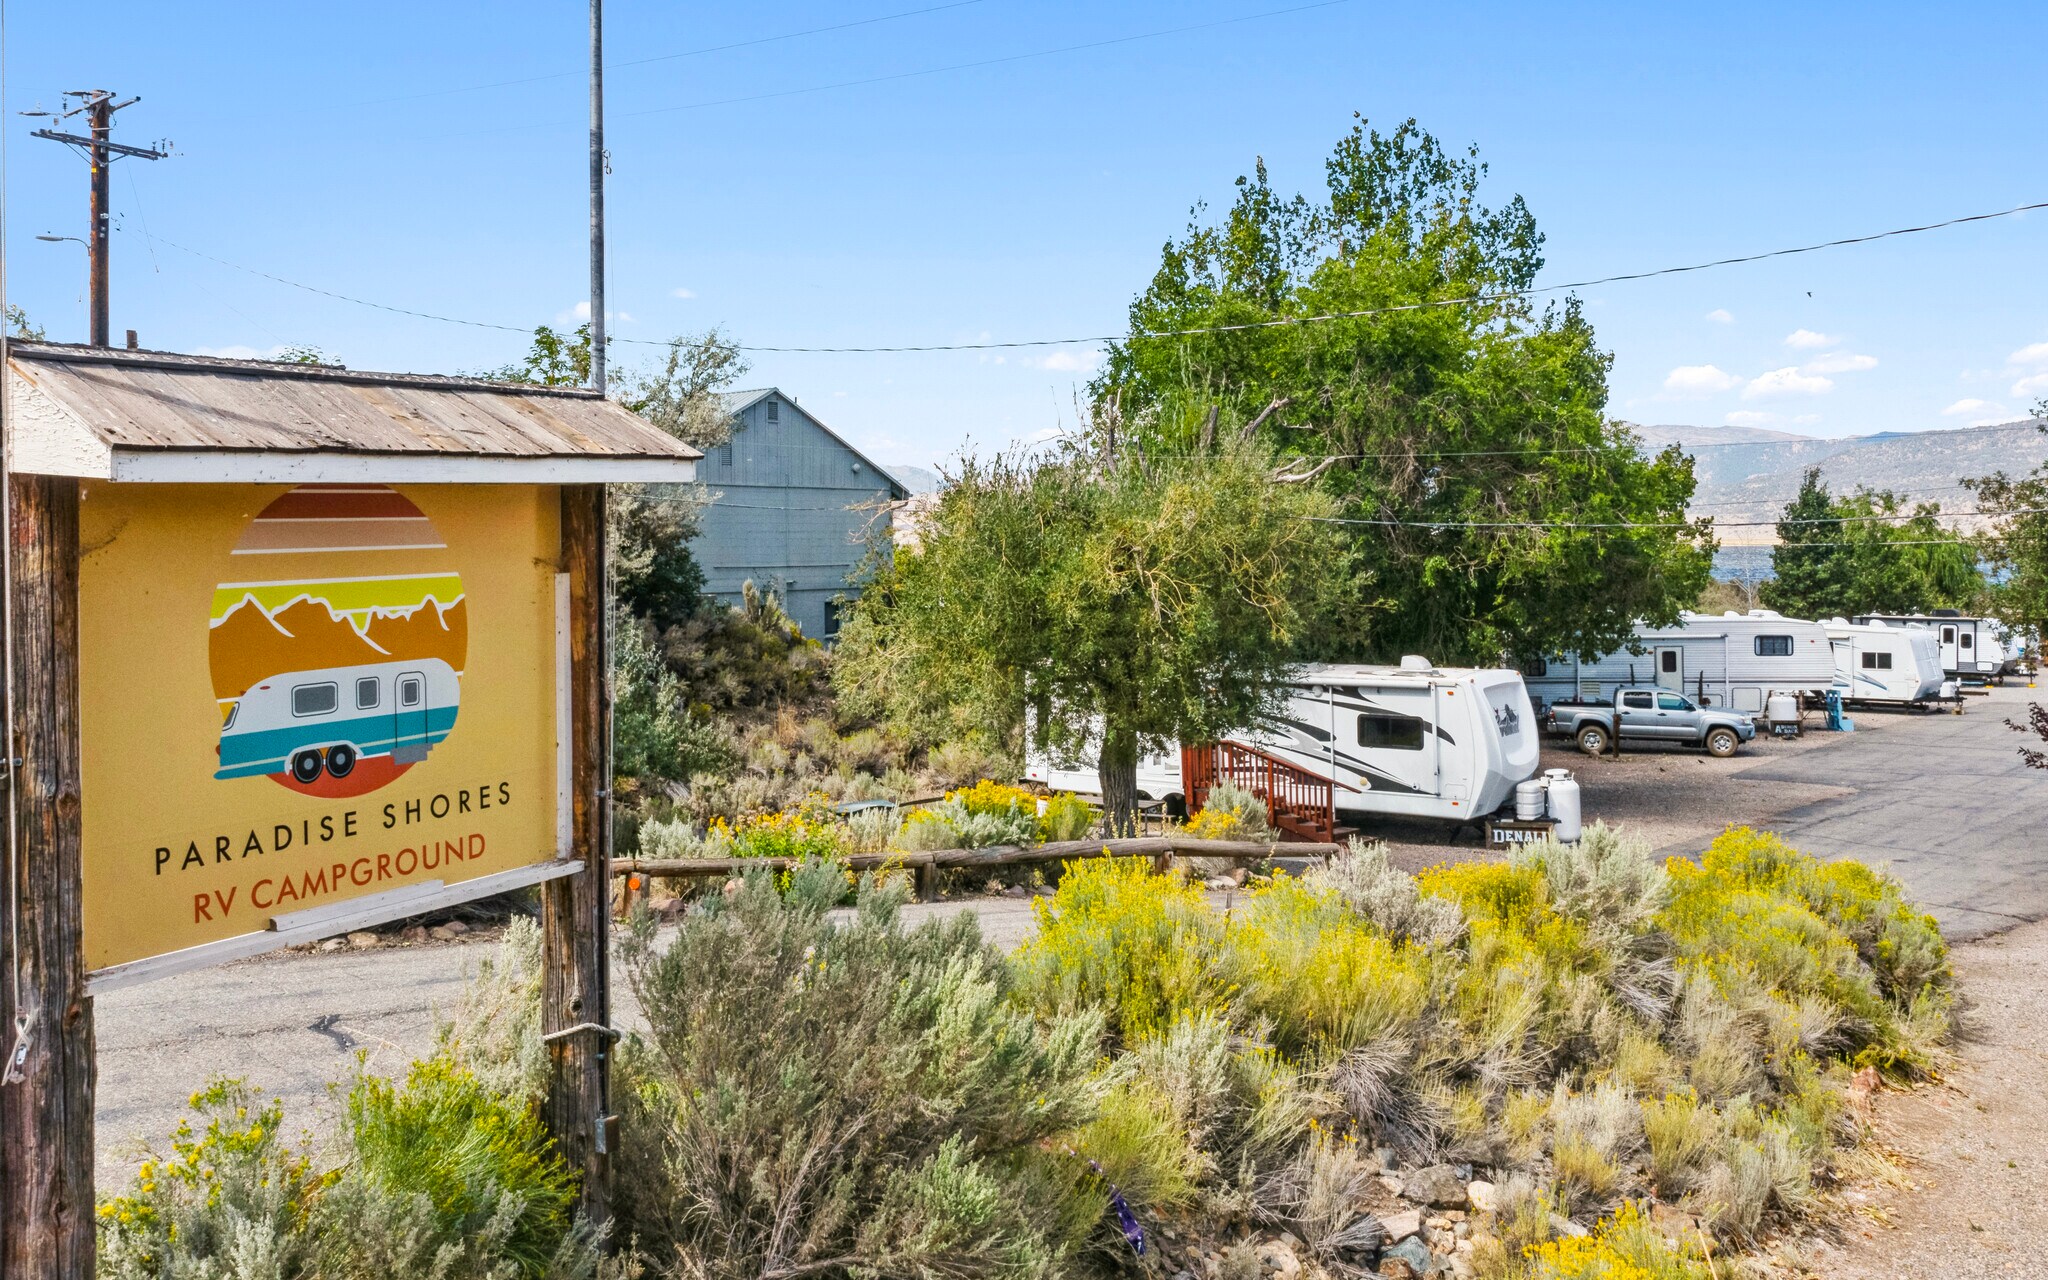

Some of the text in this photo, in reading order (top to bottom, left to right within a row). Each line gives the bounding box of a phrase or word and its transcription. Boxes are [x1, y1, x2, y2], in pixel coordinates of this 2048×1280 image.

[155, 781, 511, 876] PARADISE SHORES
[1493, 829, 1547, 844] DENALI
[194, 833, 487, 924] RV CAMPGROUND
